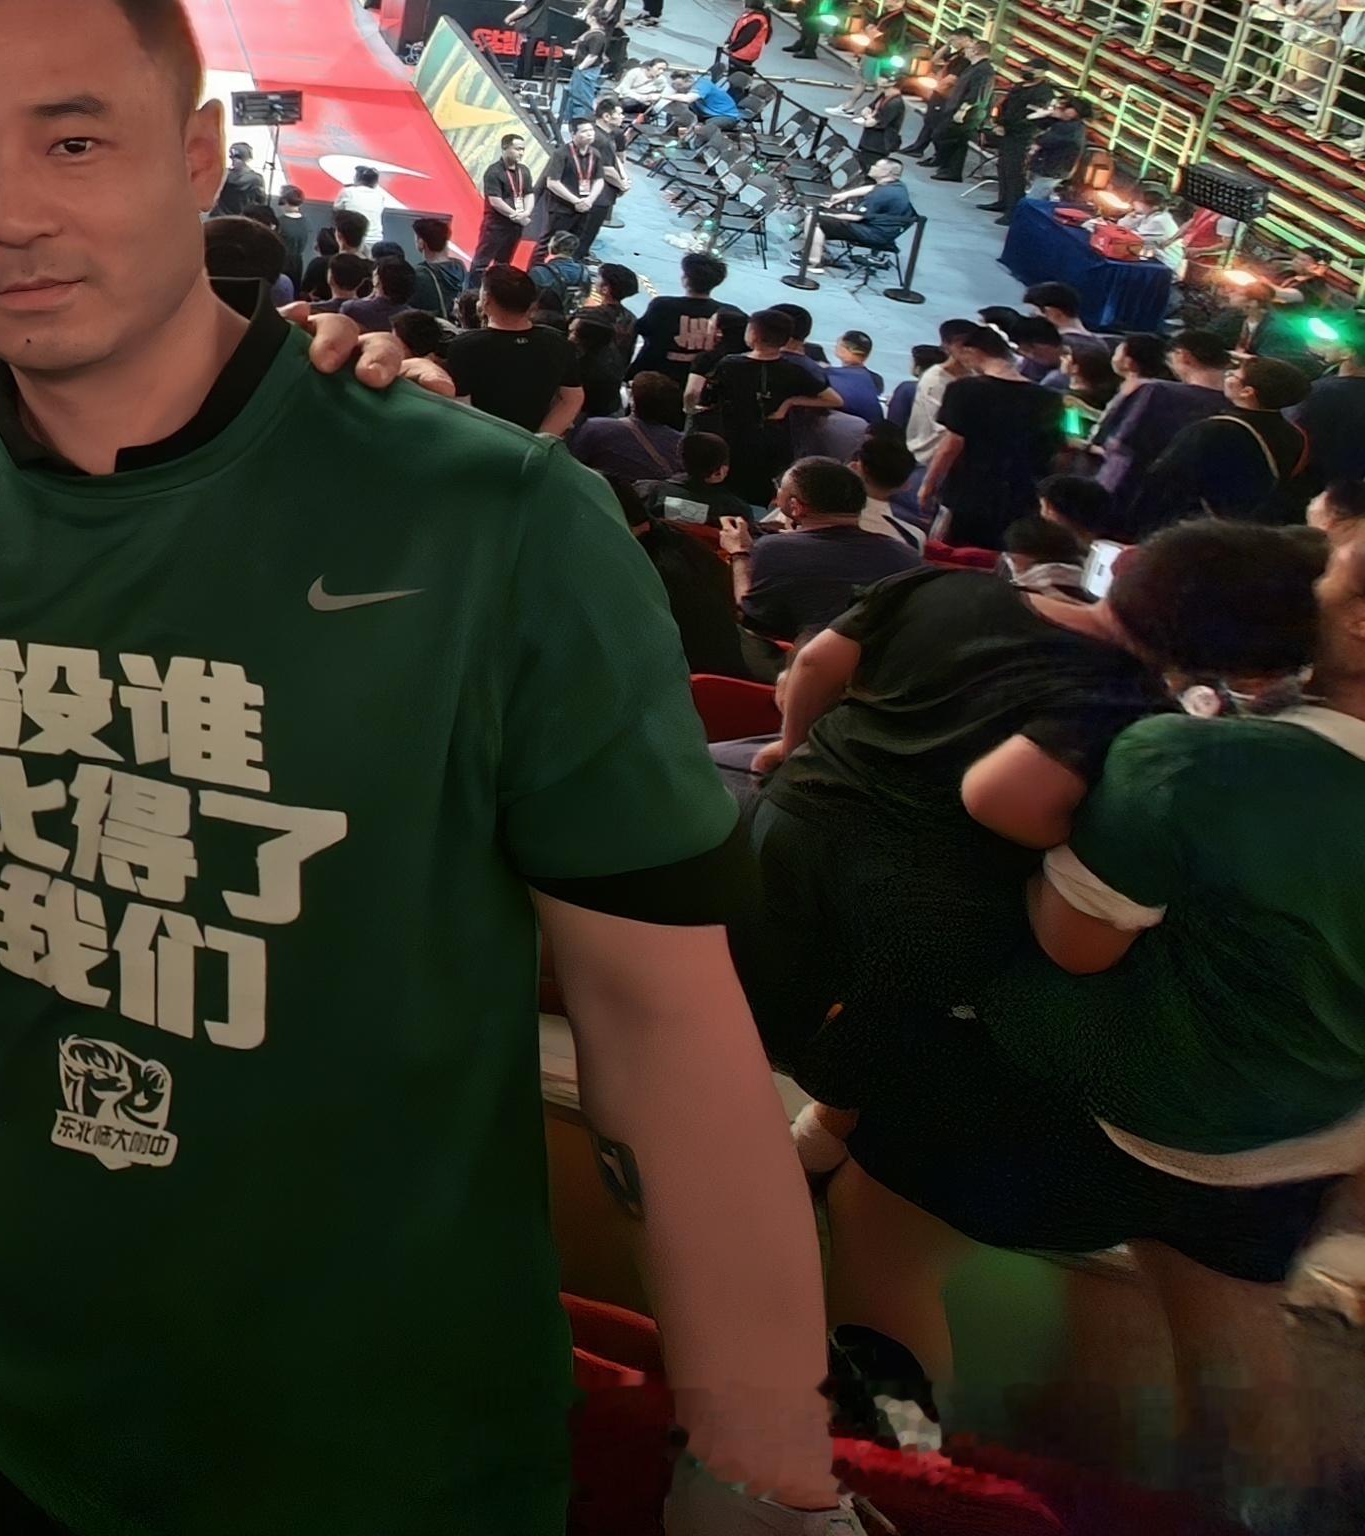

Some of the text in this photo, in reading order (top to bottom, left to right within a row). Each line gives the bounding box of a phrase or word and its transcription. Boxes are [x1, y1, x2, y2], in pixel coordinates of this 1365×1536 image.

[57, 1116, 169, 1156] 东北师大附中
